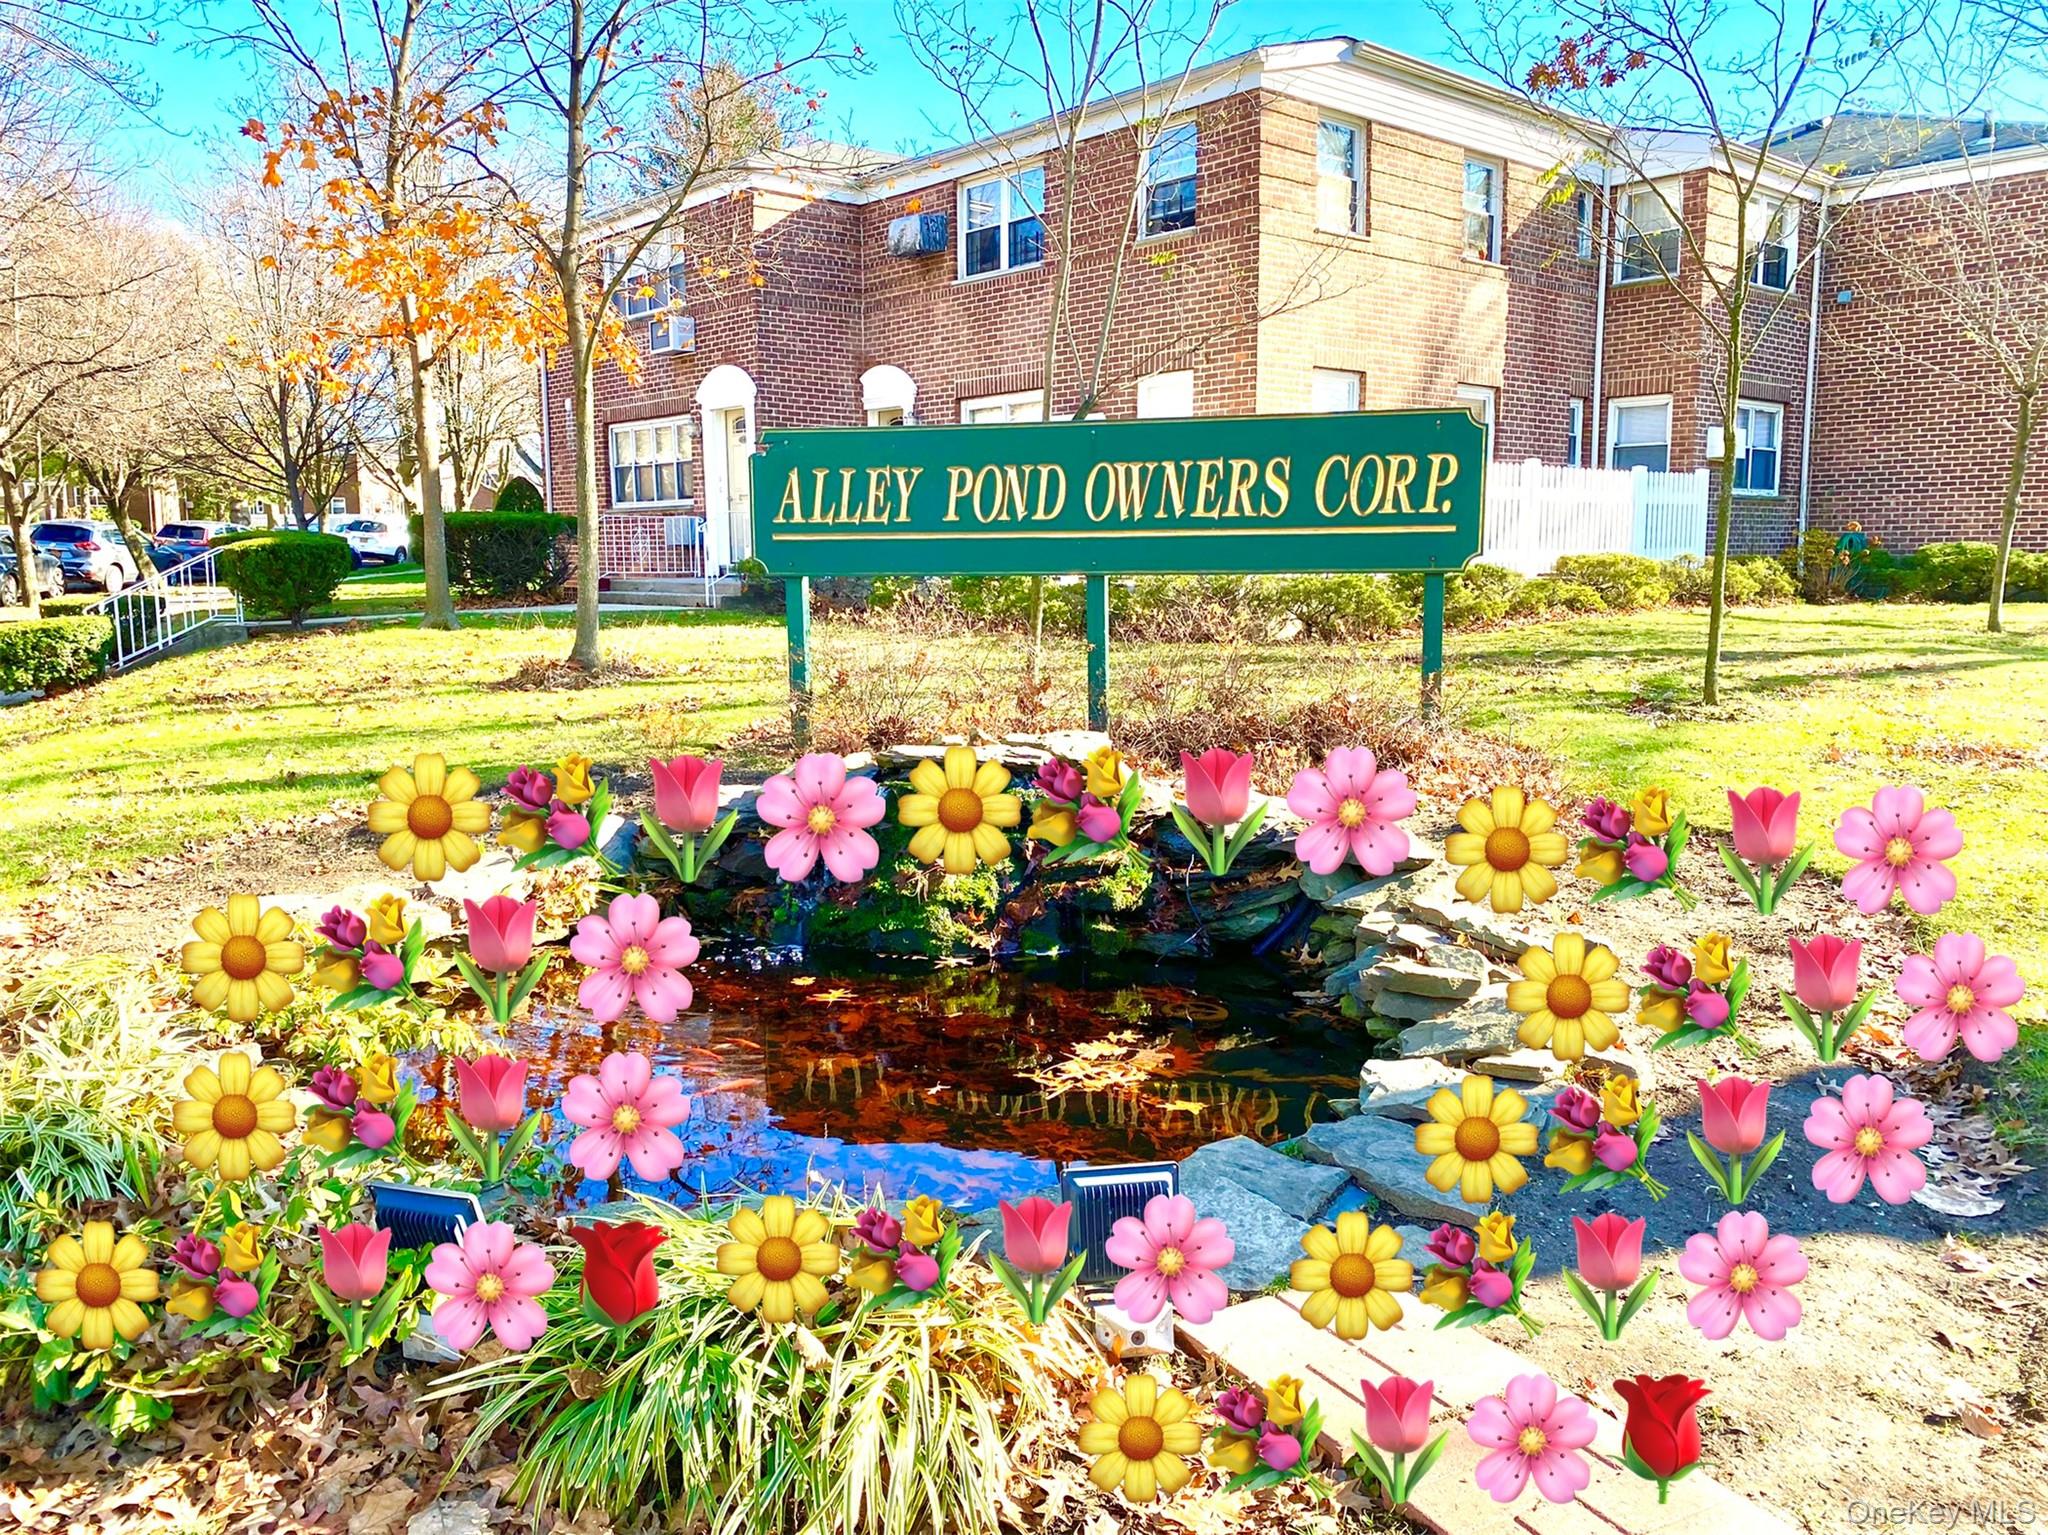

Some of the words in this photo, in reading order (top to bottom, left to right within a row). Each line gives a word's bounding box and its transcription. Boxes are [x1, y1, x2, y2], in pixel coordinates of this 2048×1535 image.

[773, 466, 923, 525] ALLEY
[943, 463, 1067, 523] POND
[1085, 456, 1291, 522] OWNERS
[1315, 453, 1460, 518] CORP.
